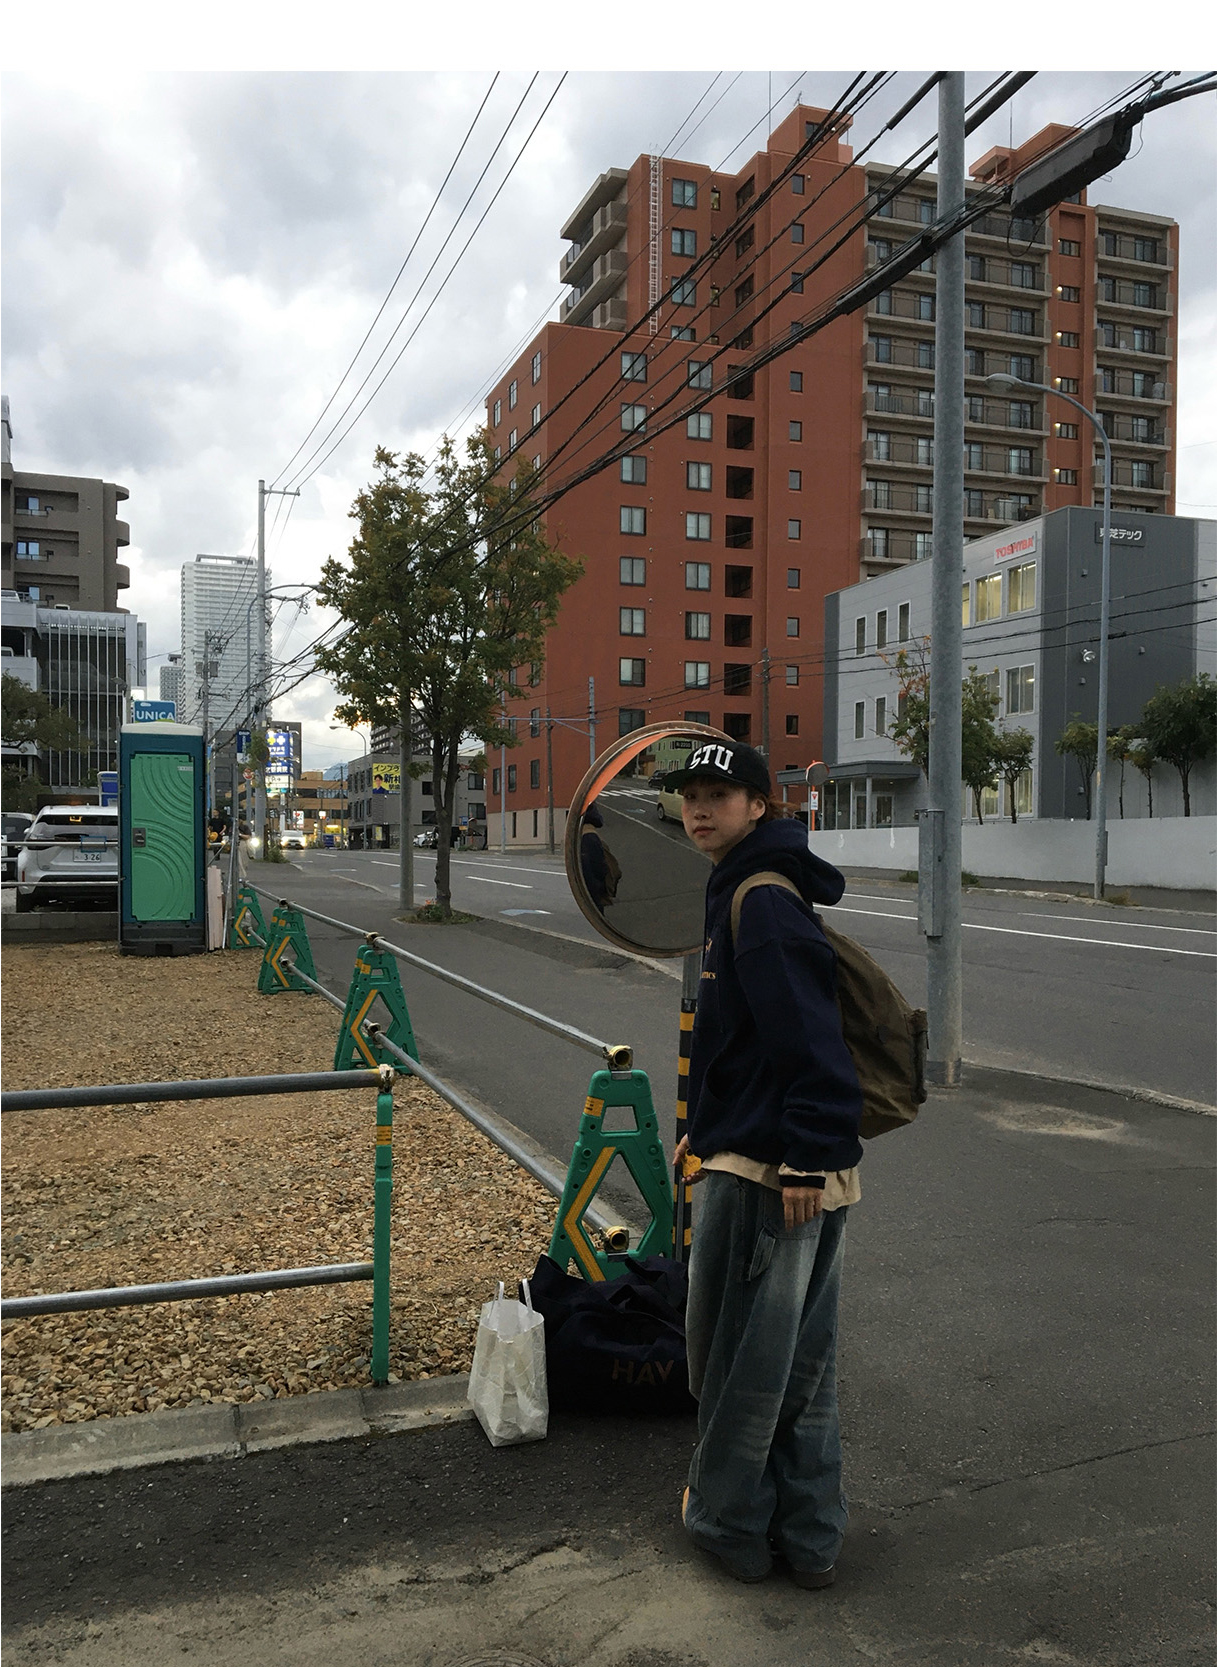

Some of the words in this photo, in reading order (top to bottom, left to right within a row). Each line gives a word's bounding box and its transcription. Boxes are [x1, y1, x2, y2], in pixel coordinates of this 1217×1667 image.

[995, 537, 1034, 559] TOSHIBA
[136, 710, 175, 721] UNICA
[688, 743, 735, 771] STU
[611, 1359, 675, 1386] HAY
